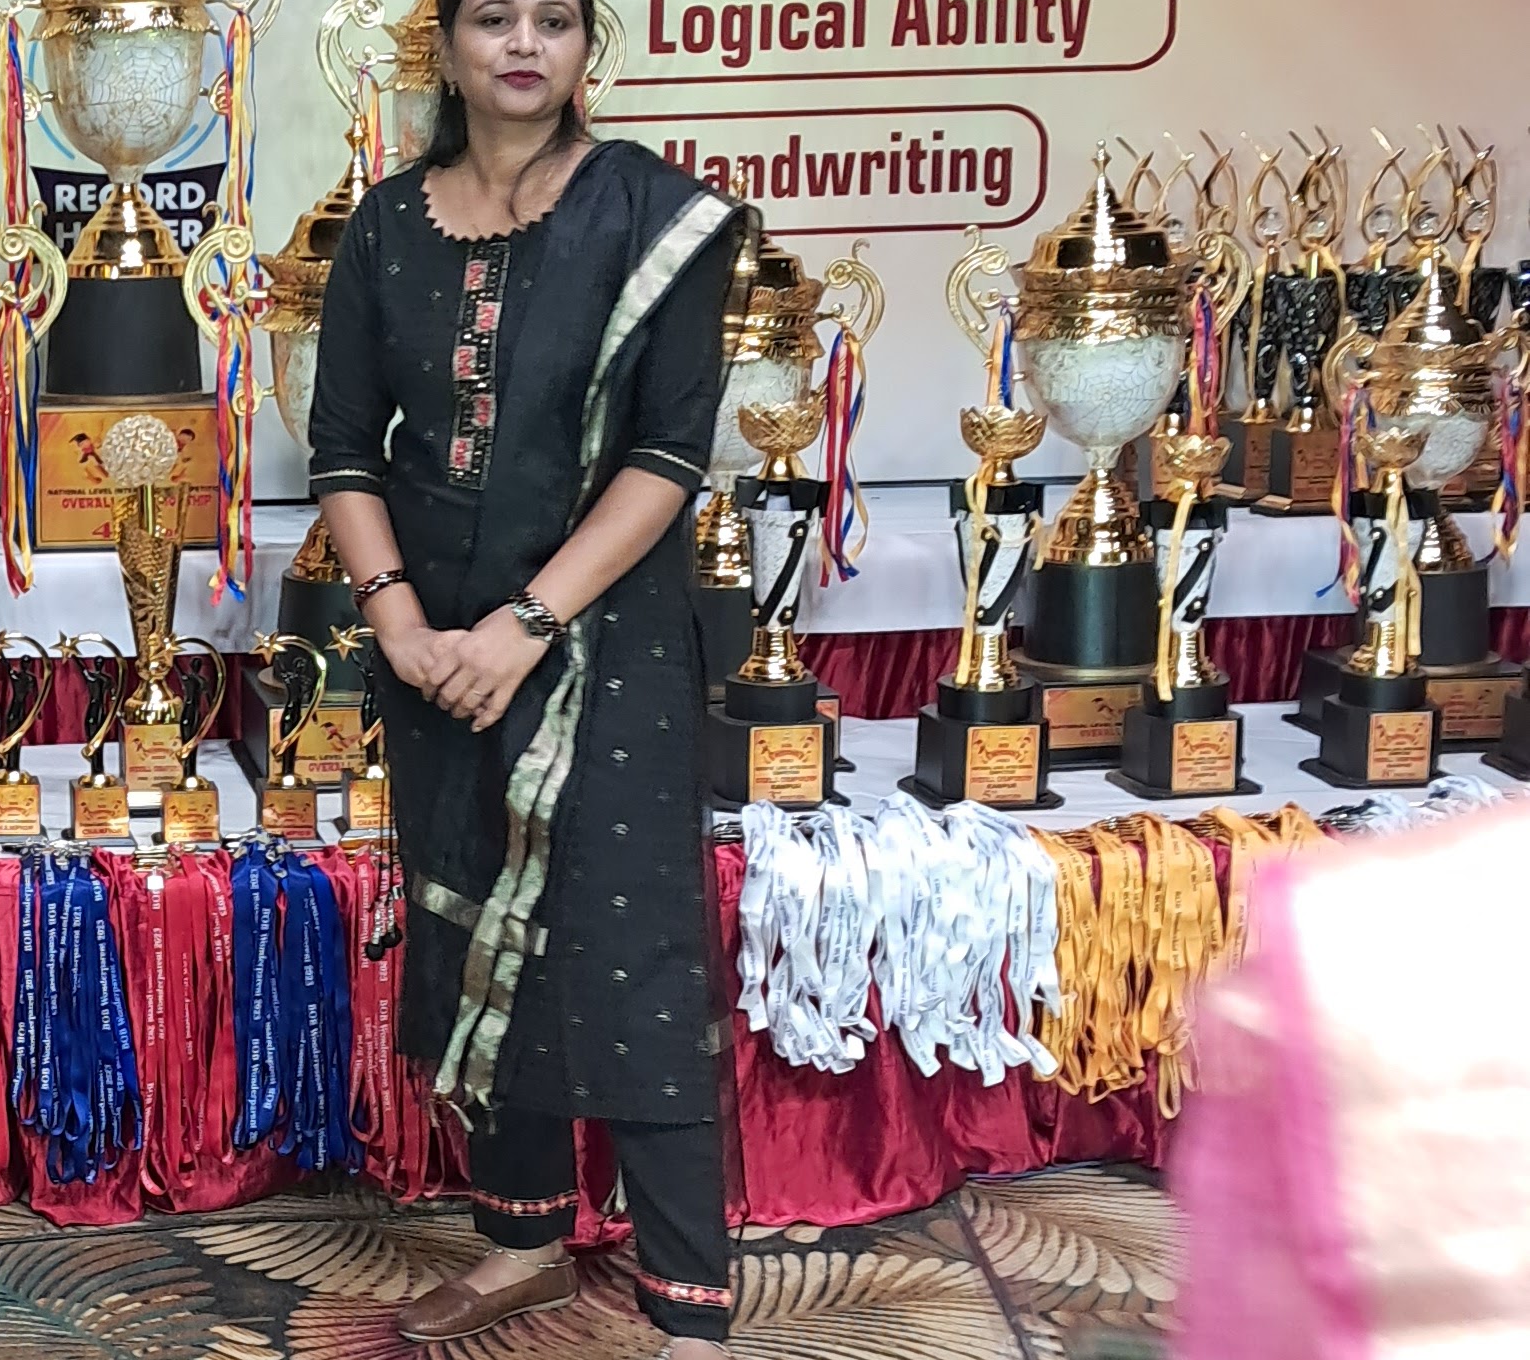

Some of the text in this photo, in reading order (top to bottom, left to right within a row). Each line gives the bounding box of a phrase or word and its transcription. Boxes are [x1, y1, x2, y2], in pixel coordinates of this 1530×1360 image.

[55, 219, 203, 250] HER
[47, 902, 57, 926] BOB
[260, 907, 271, 931] BOB
[22, 929, 33, 952] BOB
[100, 1008, 112, 1031] BOB
[307, 1003, 318, 1026] BOB
[379, 999, 389, 1022] BOB
[250, 1038, 260, 1062] BOB
